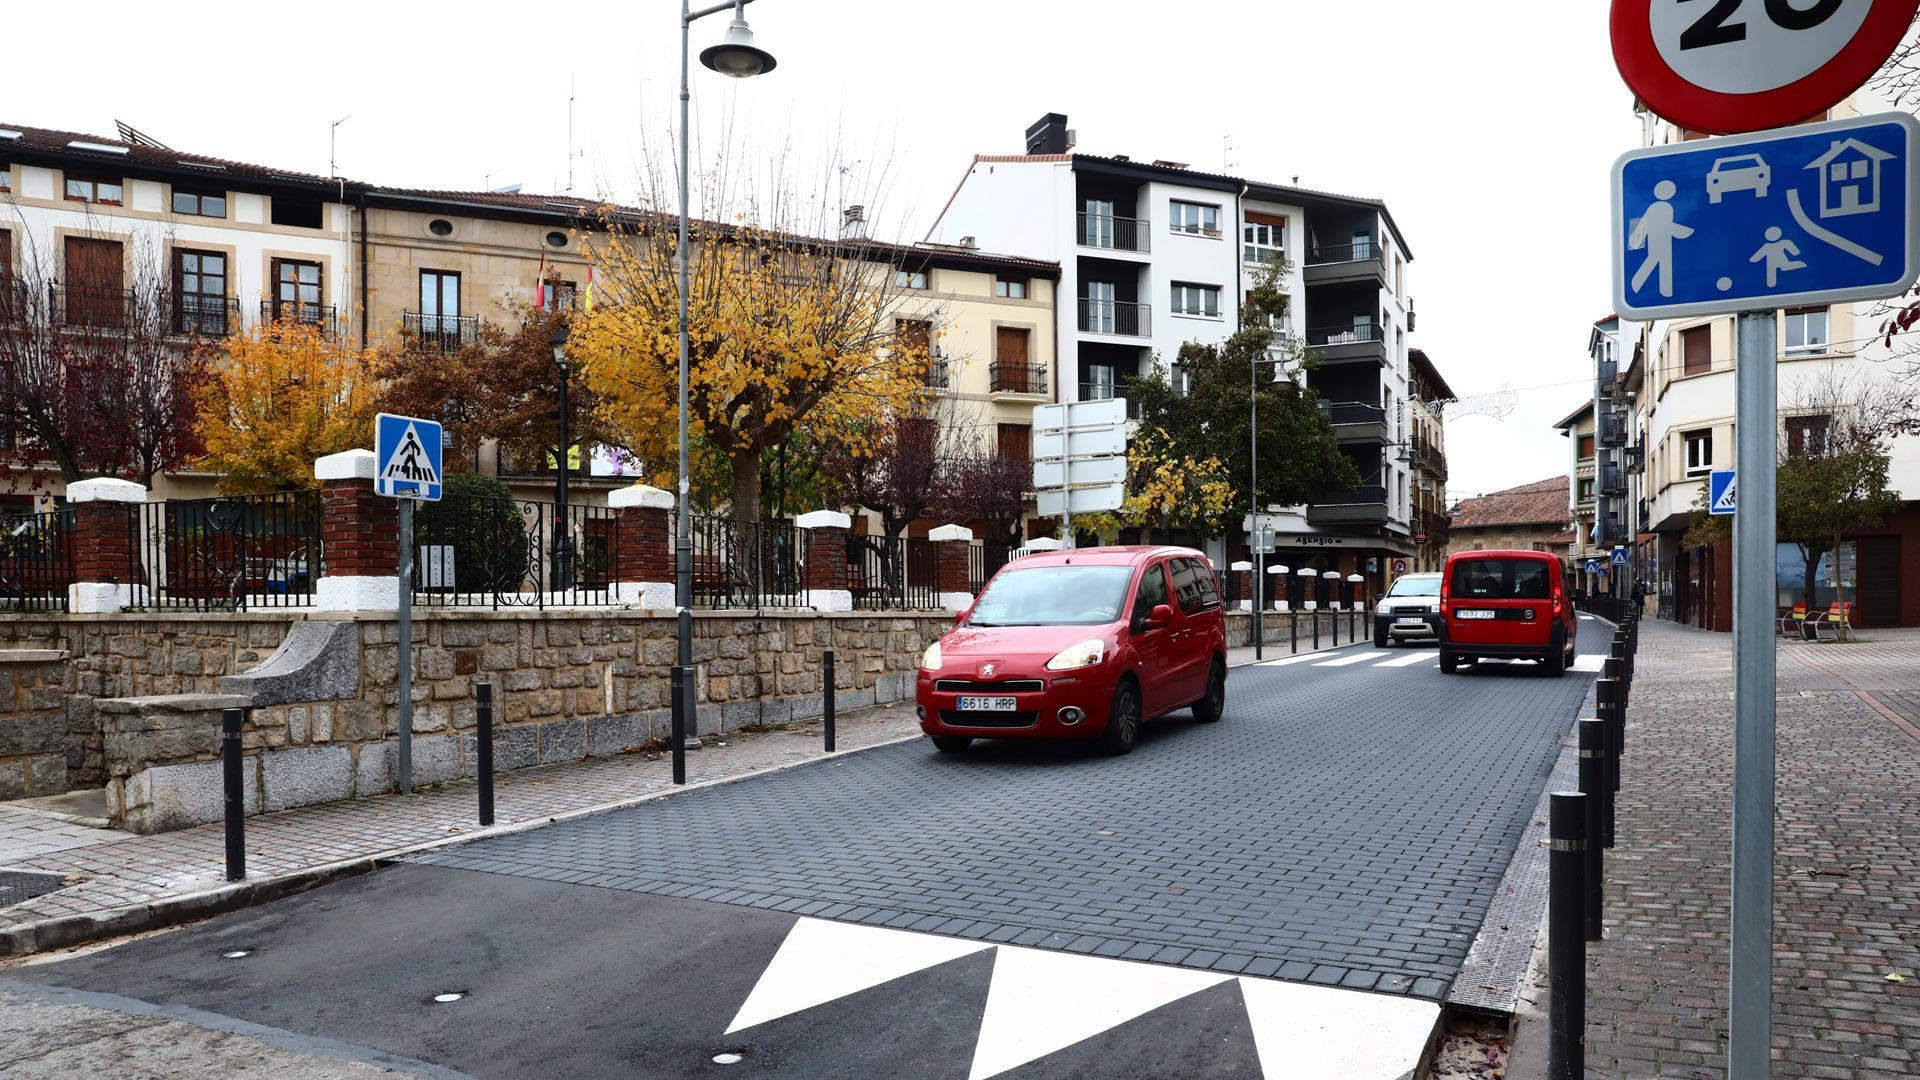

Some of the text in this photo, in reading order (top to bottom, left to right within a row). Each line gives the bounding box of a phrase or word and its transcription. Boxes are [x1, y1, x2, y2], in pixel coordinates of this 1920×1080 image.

[1296, 536, 1333, 546] ASENSIO
[962, 698, 1015, 709] 6616 HRP
